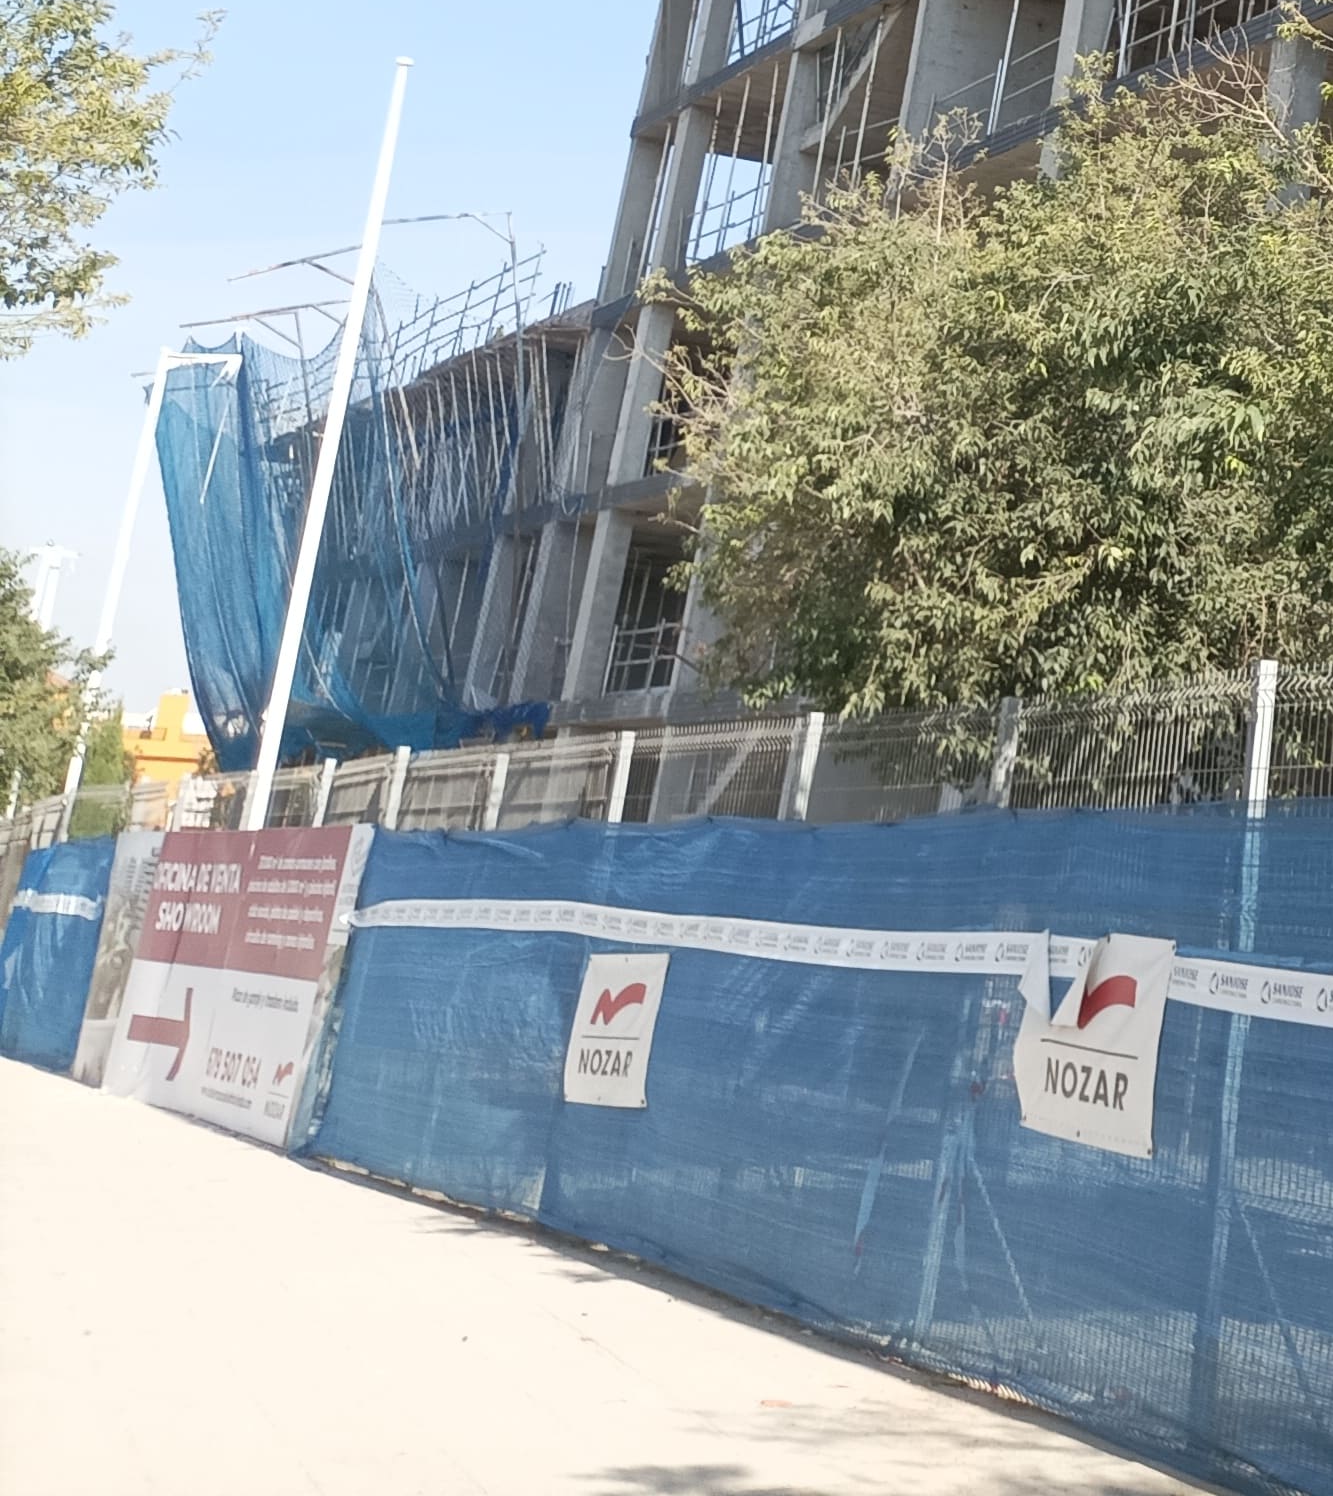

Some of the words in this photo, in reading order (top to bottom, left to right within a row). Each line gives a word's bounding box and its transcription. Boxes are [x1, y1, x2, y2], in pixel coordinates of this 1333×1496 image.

[1273, 982, 1304, 998] SANJOSE
[578, 1048, 633, 1078] NOZAR
[1044, 1057, 1129, 1111] NOZAR
